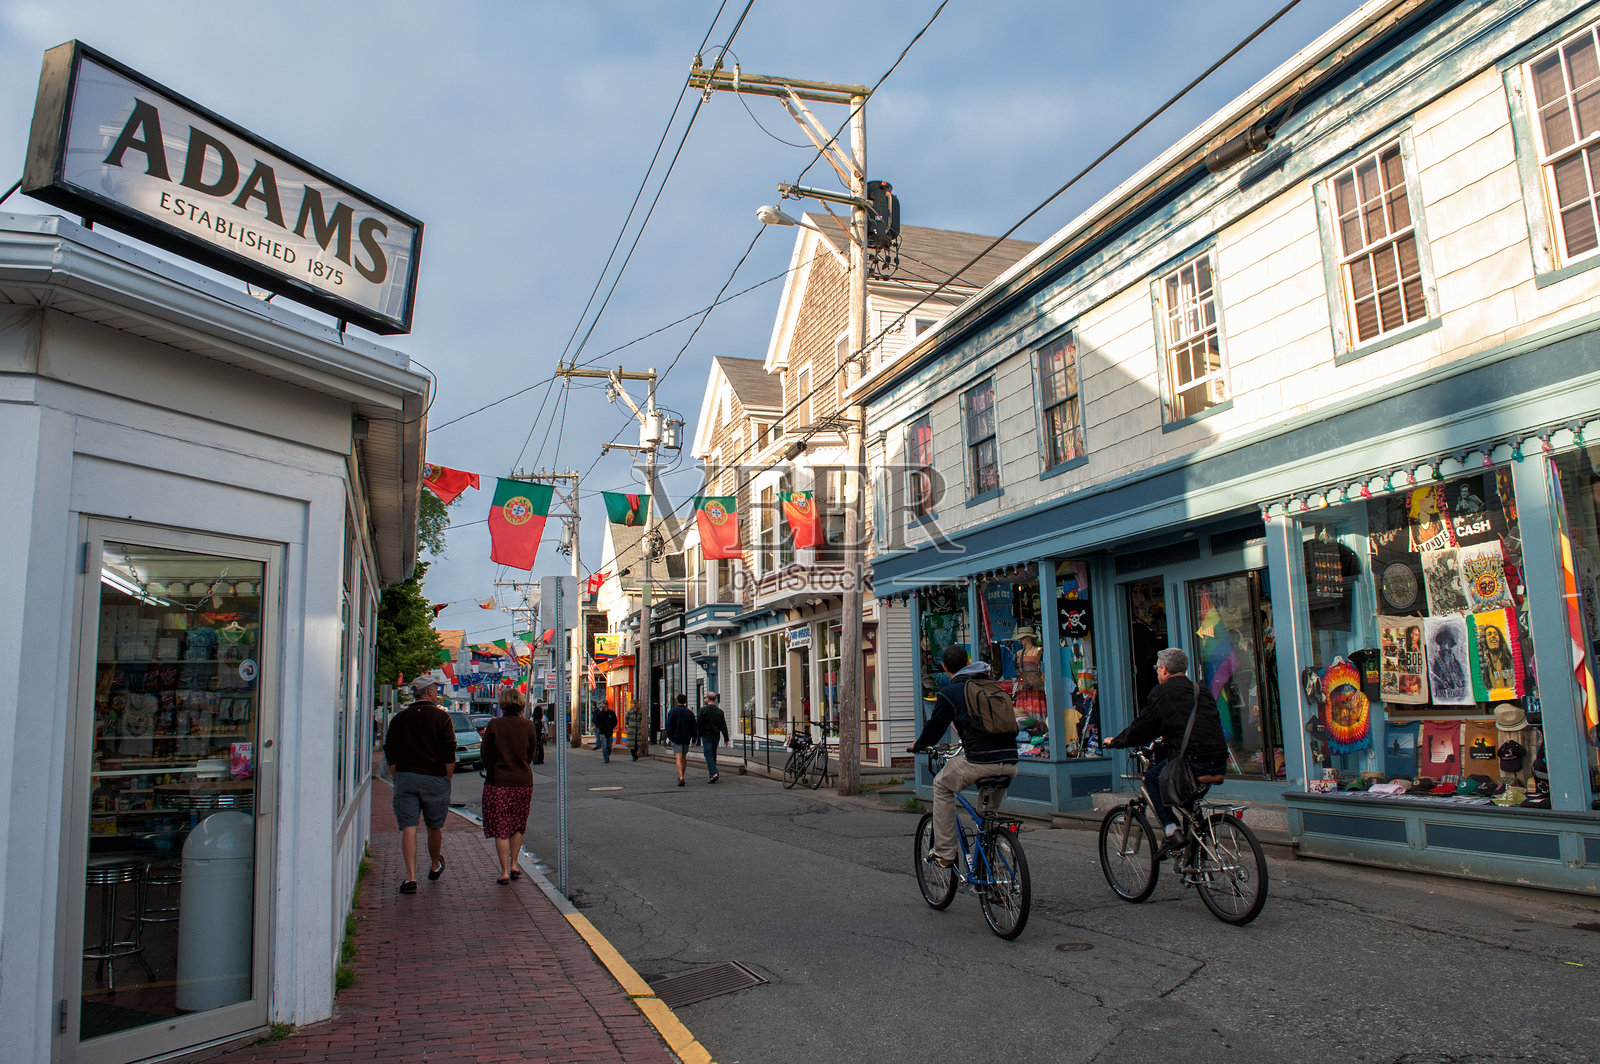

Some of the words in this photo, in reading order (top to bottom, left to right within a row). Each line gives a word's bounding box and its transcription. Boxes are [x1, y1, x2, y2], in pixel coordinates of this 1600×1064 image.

[103, 97, 388, 285] ADAMS
[159, 191, 296, 263] ESTABLISHED
[307, 258, 344, 285] 1875
[1456, 519, 1491, 538] CASH
[1405, 652, 1424, 666] BOB
[238, 743, 251, 751] PULL
